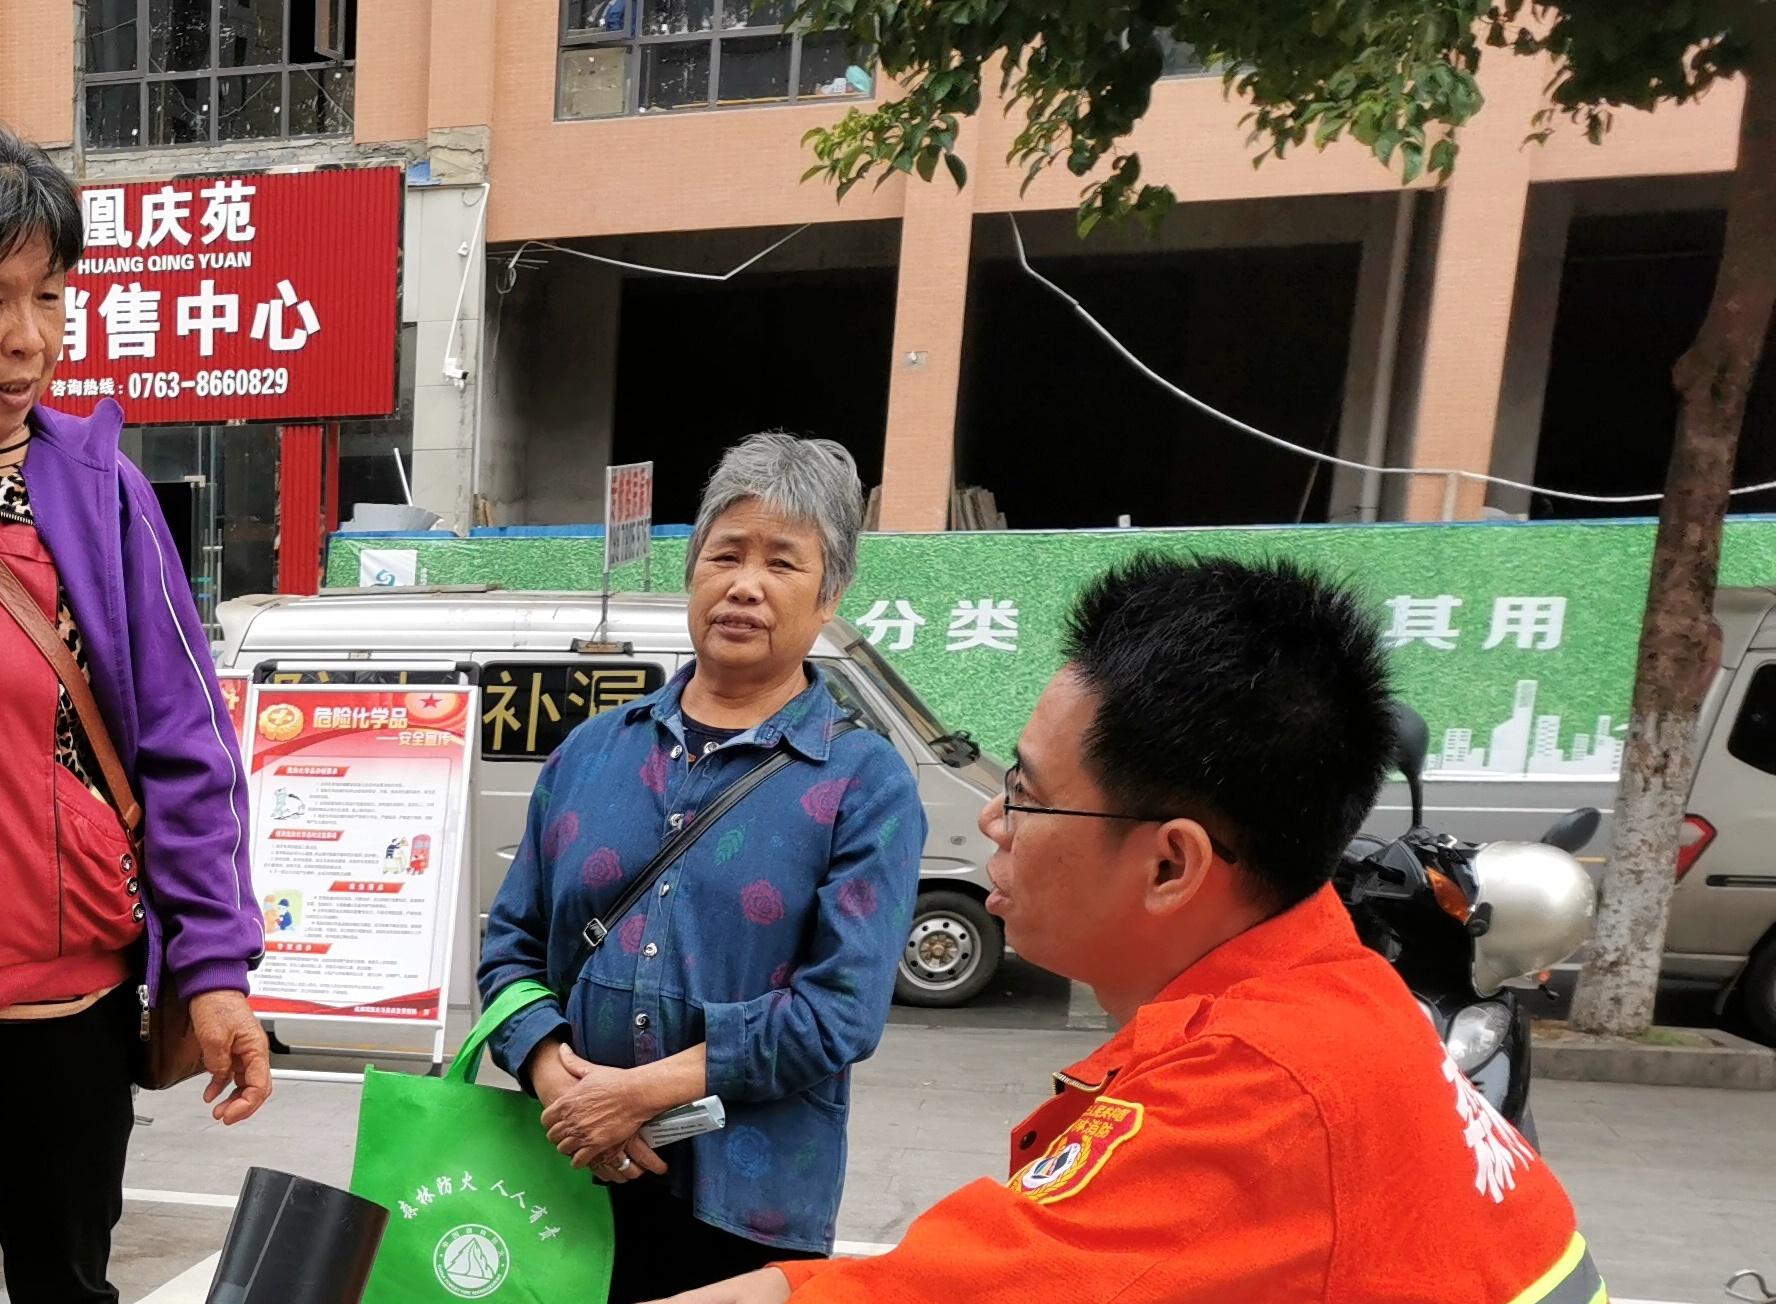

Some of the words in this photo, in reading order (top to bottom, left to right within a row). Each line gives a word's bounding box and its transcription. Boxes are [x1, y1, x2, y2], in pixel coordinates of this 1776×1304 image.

[82, 180, 257, 250] 凰庆苑
[78, 256, 144, 275] HUANG
[147, 254, 195, 273] QING
[199, 251, 252, 270] YUAN
[856, 598, 1020, 652] 分类
[1385, 595, 1567, 652] 其用
[313, 706, 409, 730] 危险化学品
[490, 1179, 561, 1242] 人人有责
